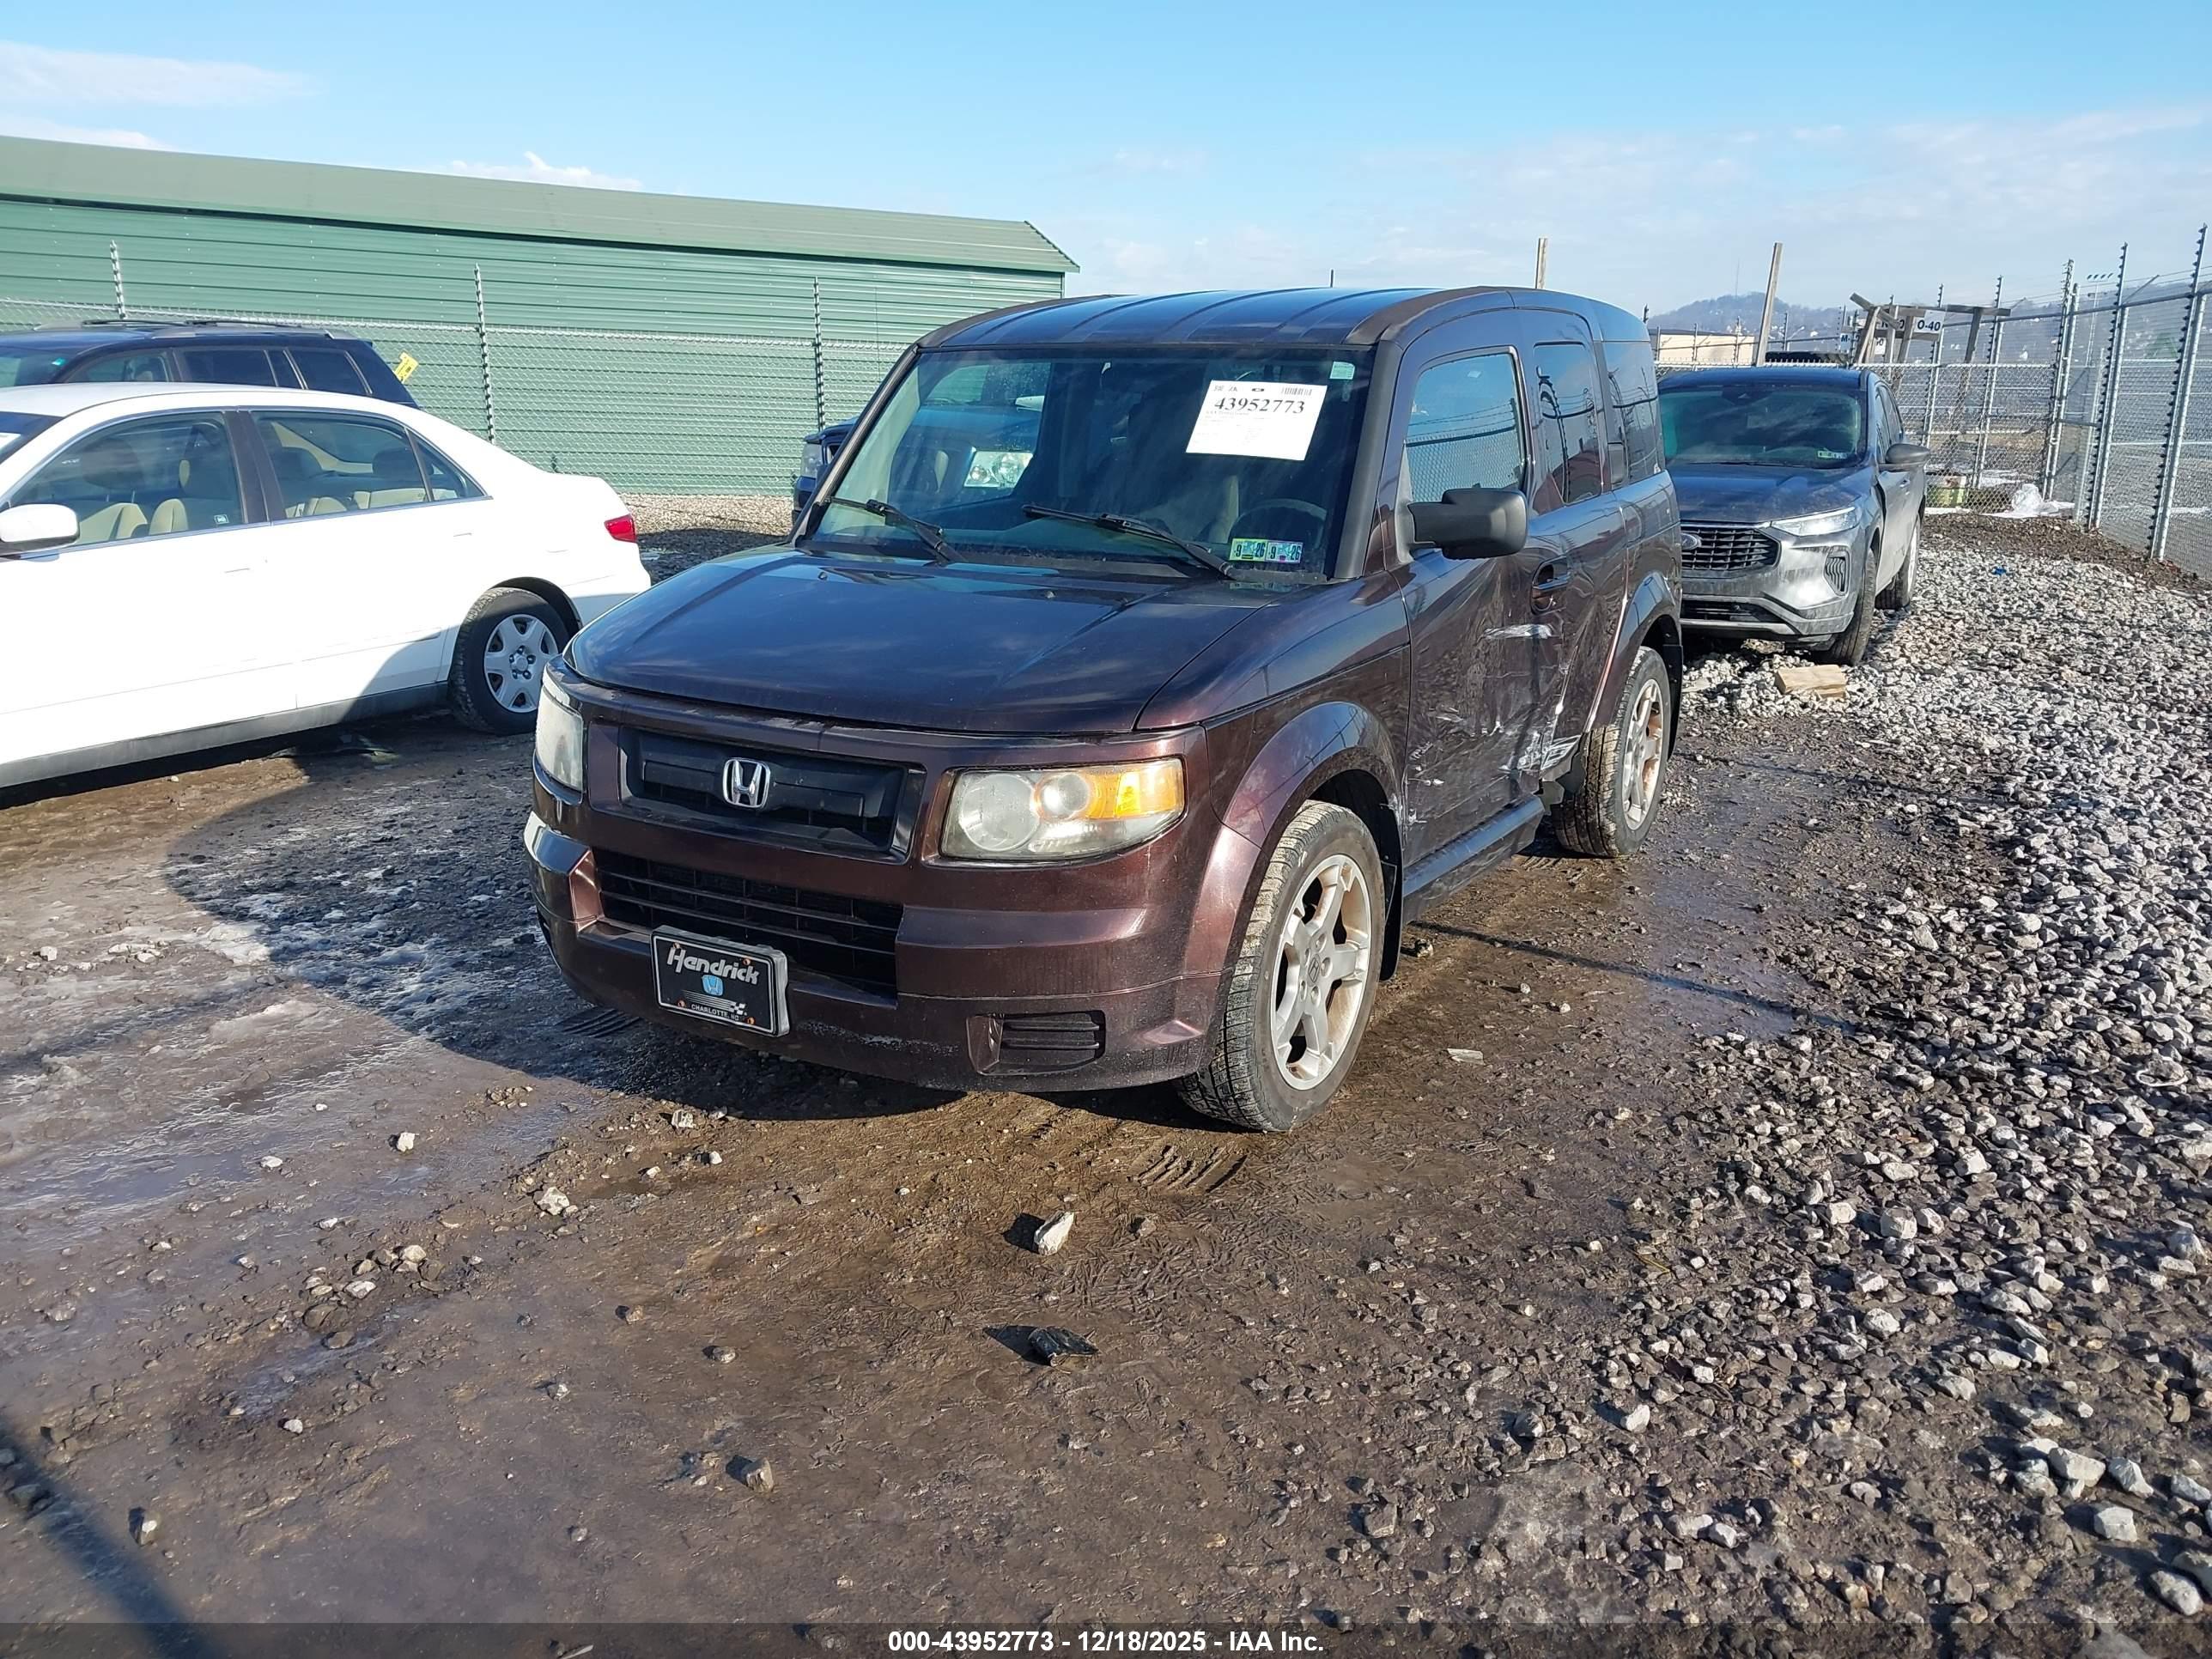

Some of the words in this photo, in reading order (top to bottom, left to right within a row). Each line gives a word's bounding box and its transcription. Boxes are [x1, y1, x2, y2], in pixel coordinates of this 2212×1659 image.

[1917, 319, 1941, 331] O-40
[1214, 397, 1305, 414] 43952773
[666, 946, 760, 985] Hendrick
